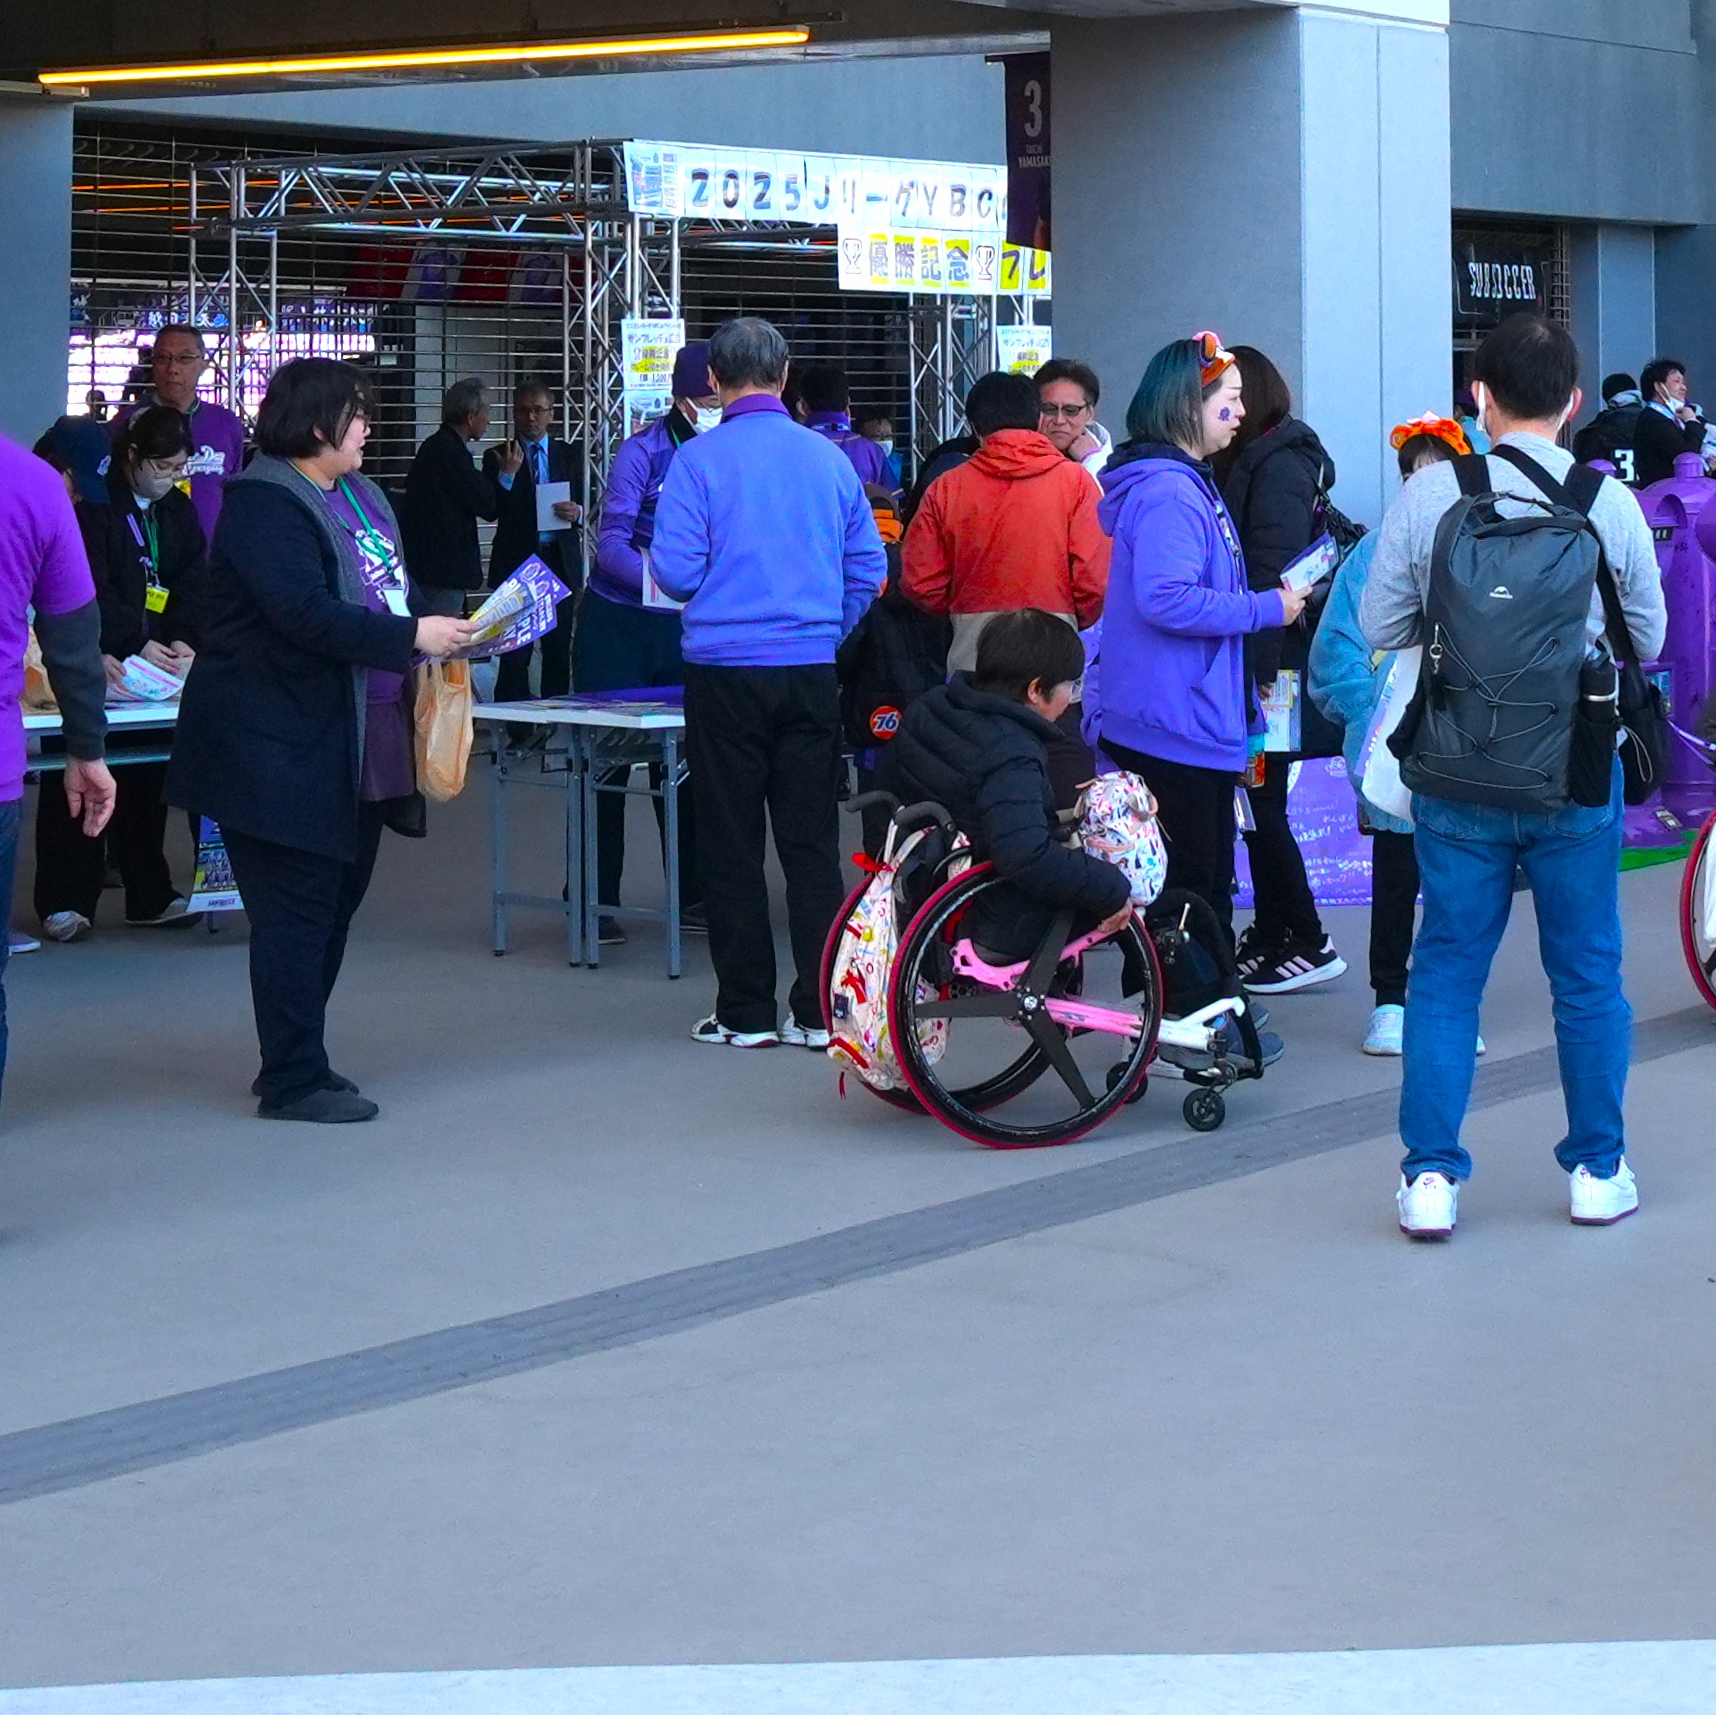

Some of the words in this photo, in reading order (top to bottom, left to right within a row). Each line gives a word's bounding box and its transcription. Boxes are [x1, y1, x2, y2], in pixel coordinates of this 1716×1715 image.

[1024, 79, 1042, 138] 3
[691, 168, 1007, 219] 2025JリーグYBC
[872, 711, 899, 732] 76
